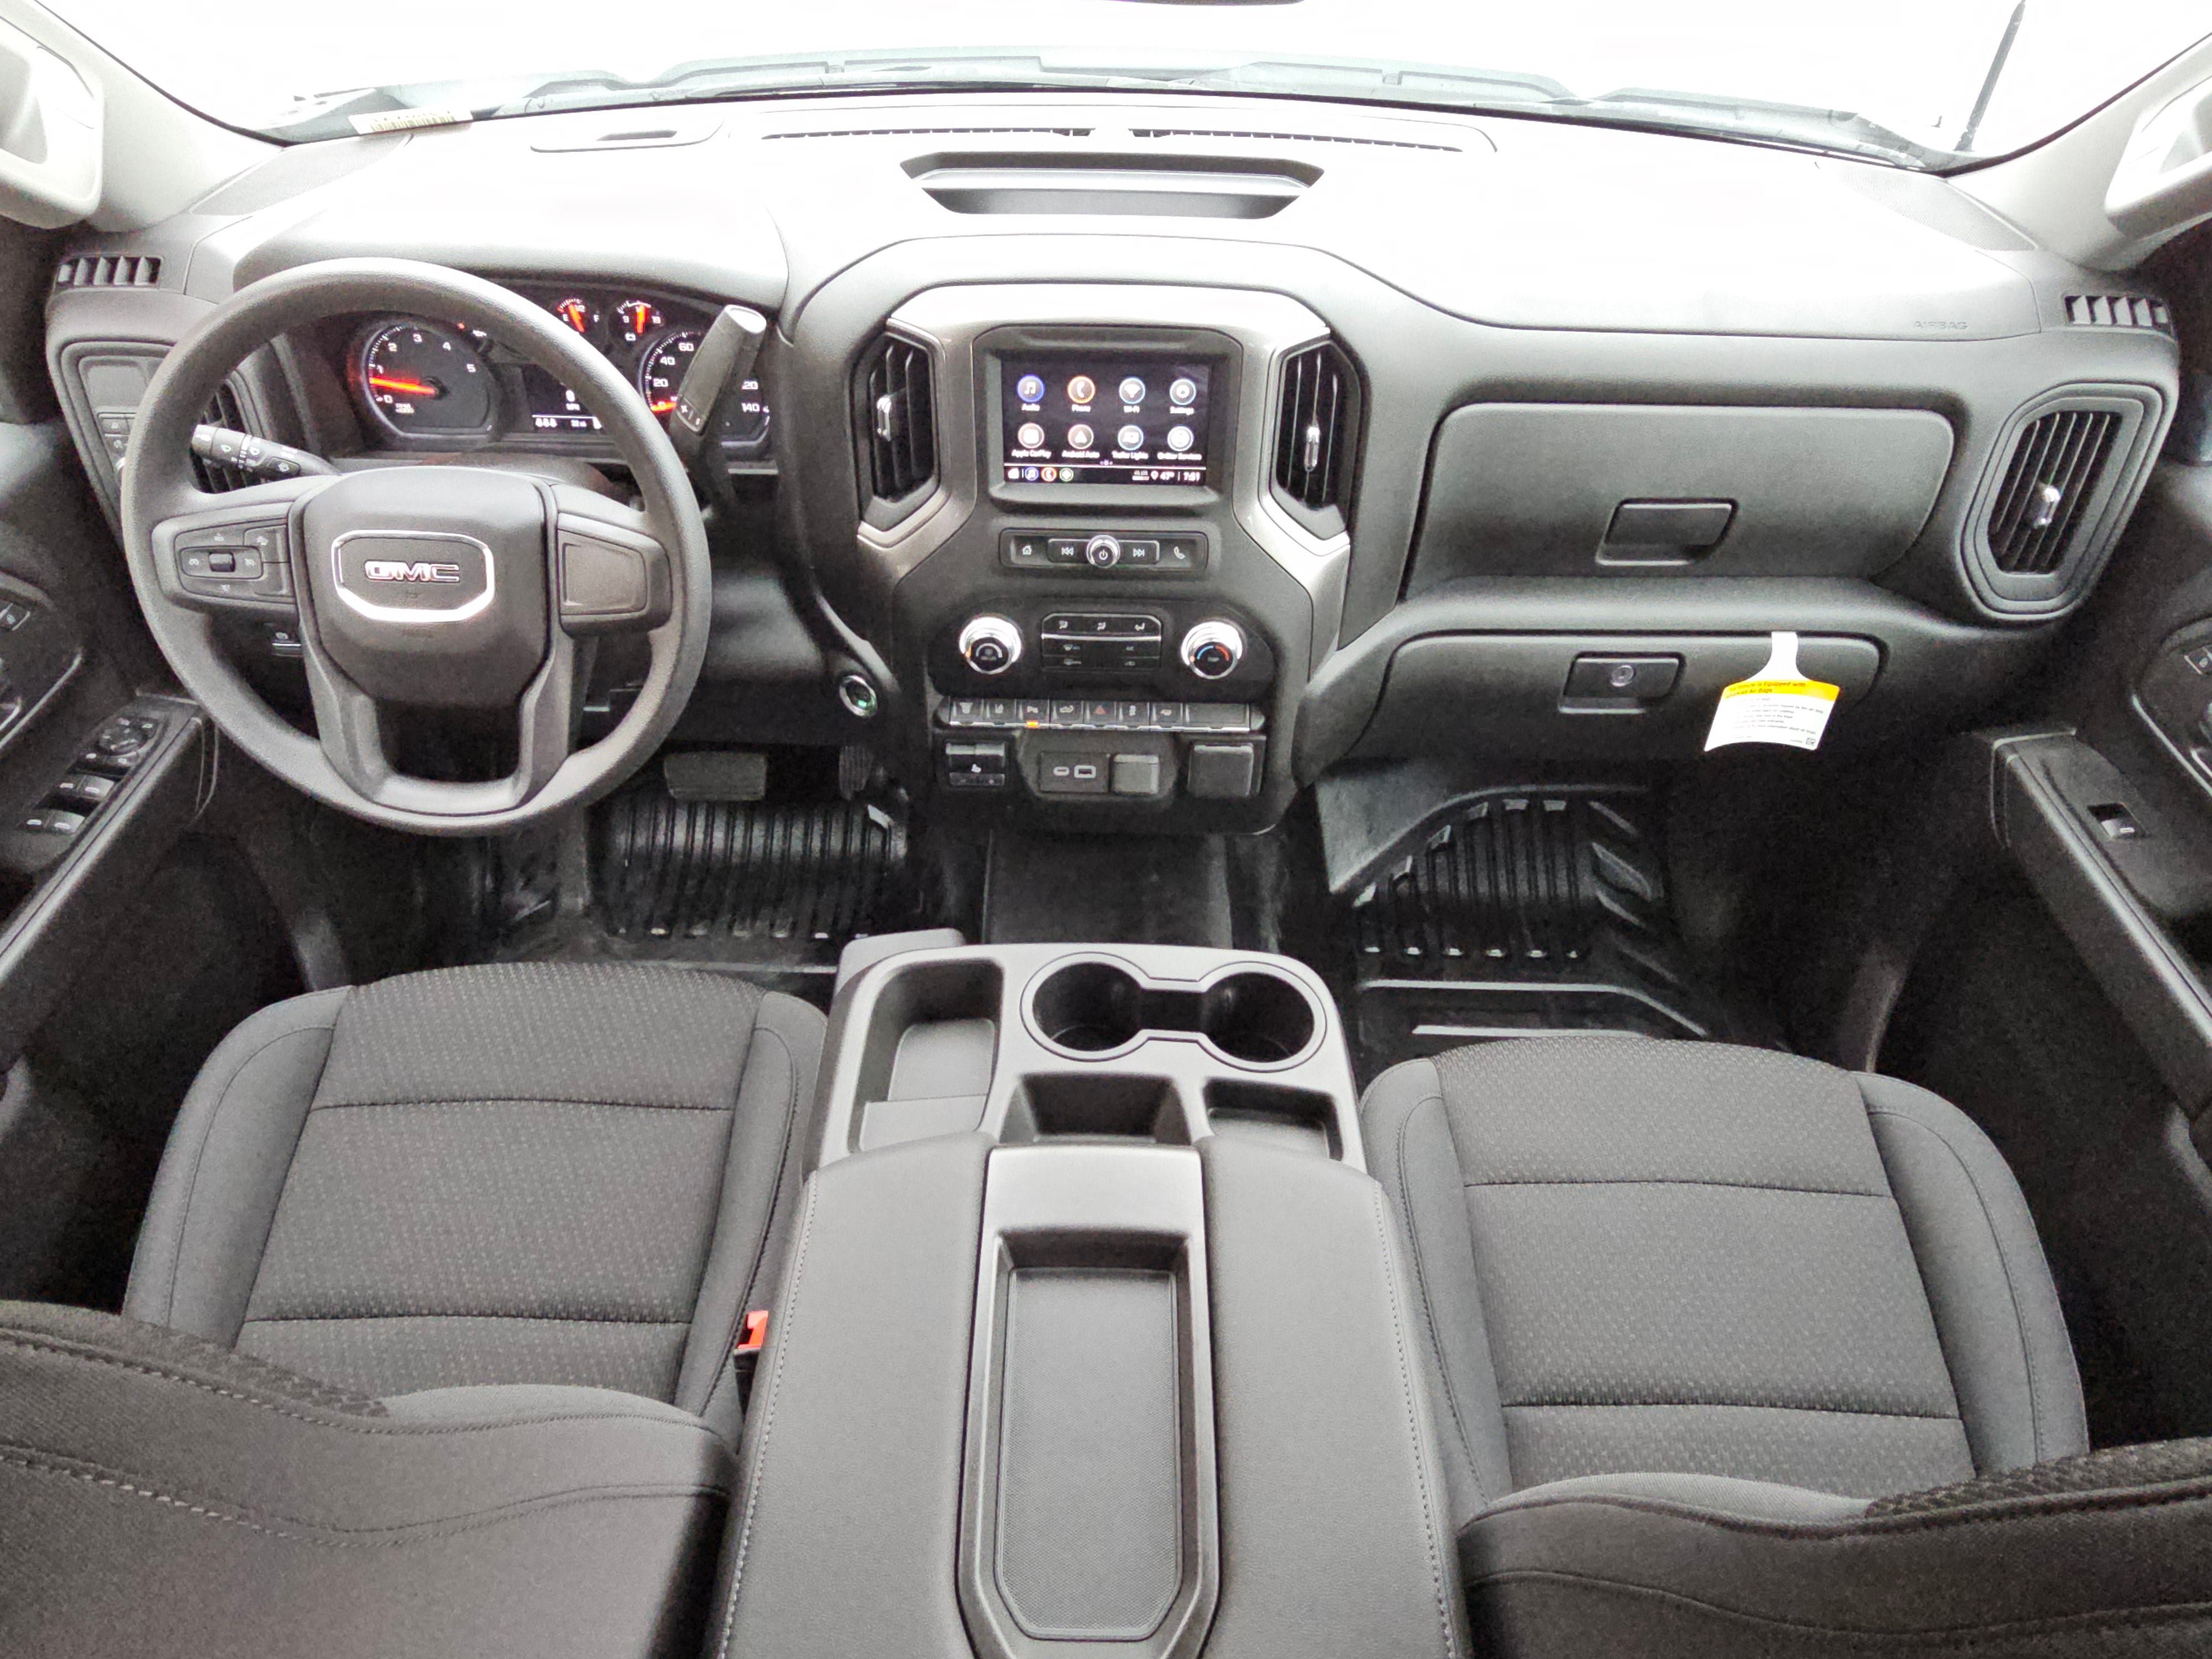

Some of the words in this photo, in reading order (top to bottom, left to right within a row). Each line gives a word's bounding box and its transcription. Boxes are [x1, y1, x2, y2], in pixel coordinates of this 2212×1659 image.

[562, 314, 569, 322] E
[593, 314, 600, 323] F
[413, 333, 422, 343] 3
[388, 342, 398, 352] 2
[442, 342, 451, 351] 4
[678, 342, 695, 352] 60
[660, 357, 676, 366] 40
[377, 365, 384, 374] 1
[466, 363, 476, 373] 5
[653, 378, 669, 388] 20
[383, 394, 393, 404] 0
[742, 403, 760, 413] 140
[364, 561, 461, 582] GMC
